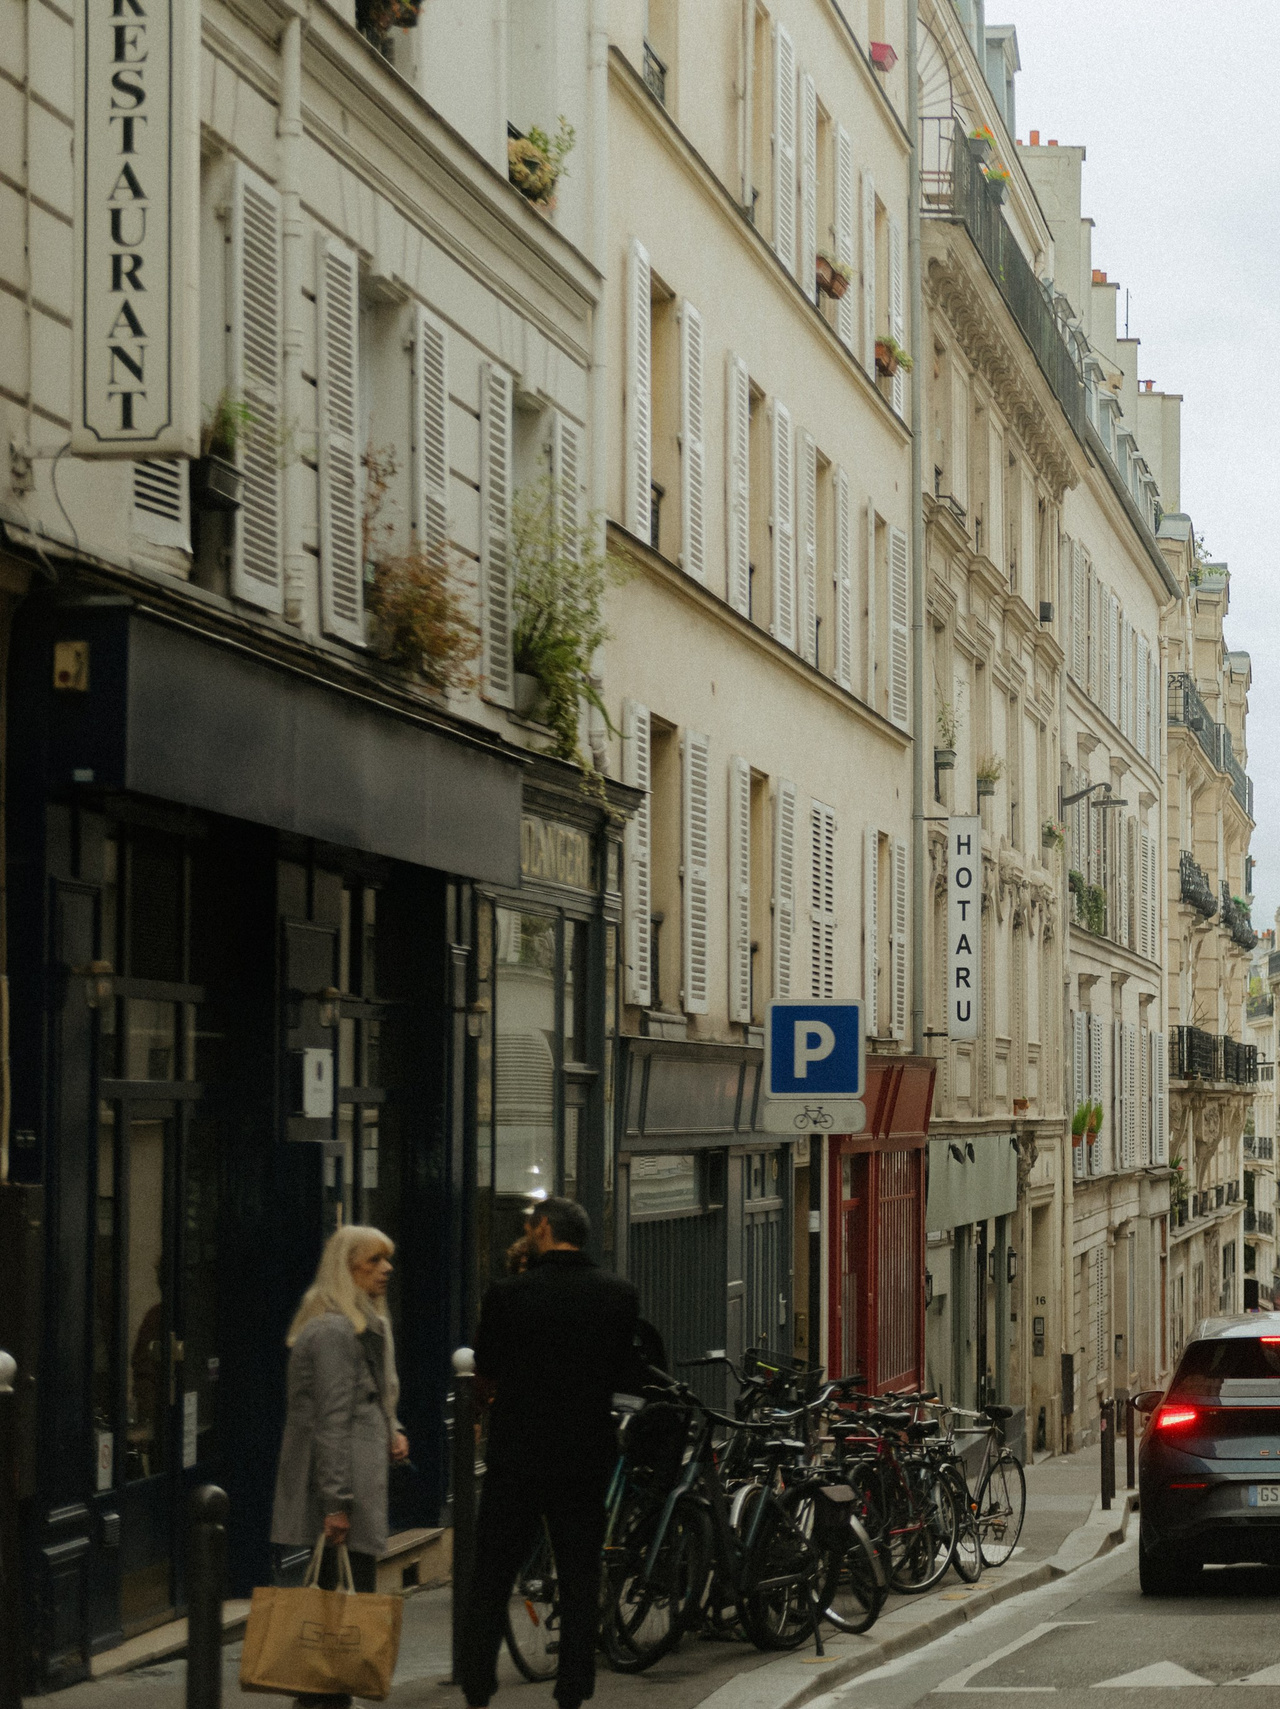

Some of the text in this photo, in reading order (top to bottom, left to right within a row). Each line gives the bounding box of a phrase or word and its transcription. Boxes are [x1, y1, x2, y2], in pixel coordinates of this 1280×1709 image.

[955, 834, 972, 1022] HOTARU
[794, 1020, 836, 1078] P
[1036, 1296, 1046, 1305] 16
